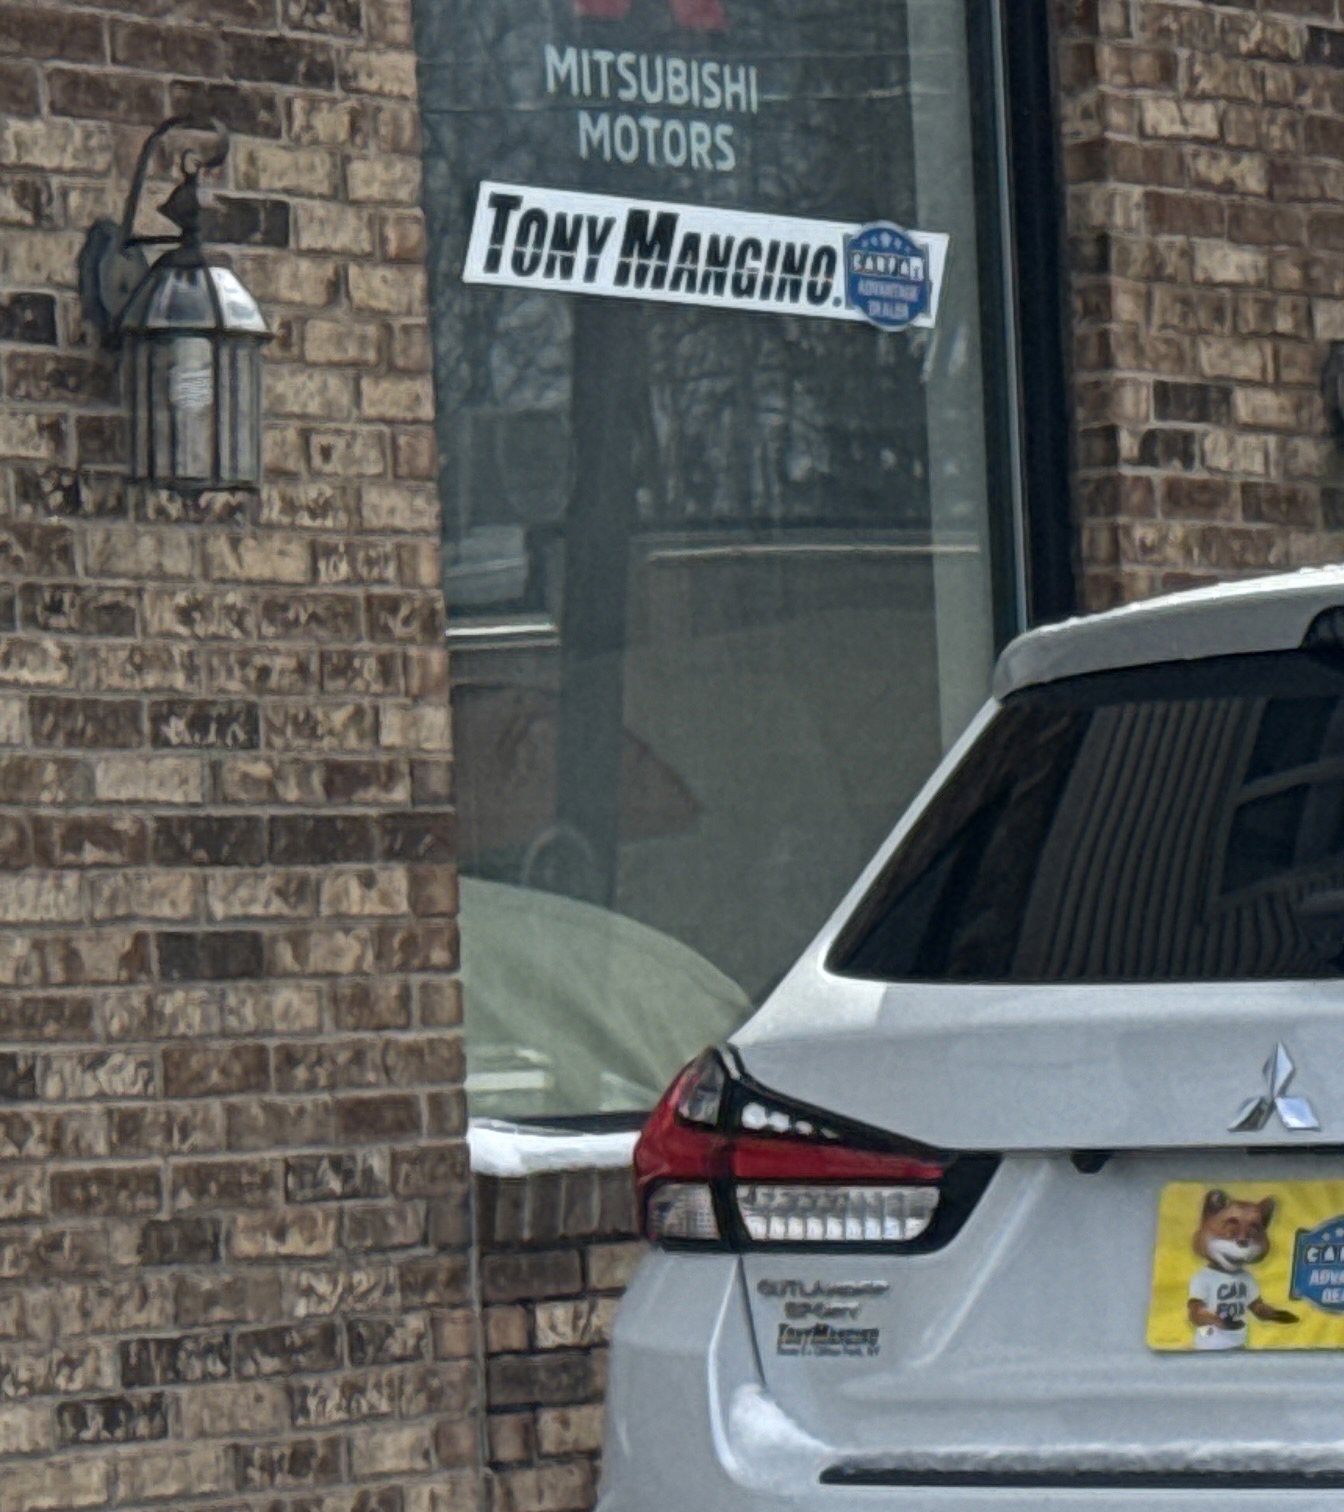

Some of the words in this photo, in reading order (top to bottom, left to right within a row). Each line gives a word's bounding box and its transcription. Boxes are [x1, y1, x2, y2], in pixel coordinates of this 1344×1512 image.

[544, 44, 758, 114] MITSUBISHI
[578, 110, 736, 171] MOTORS
[1217, 1282, 1247, 1300] CAR
